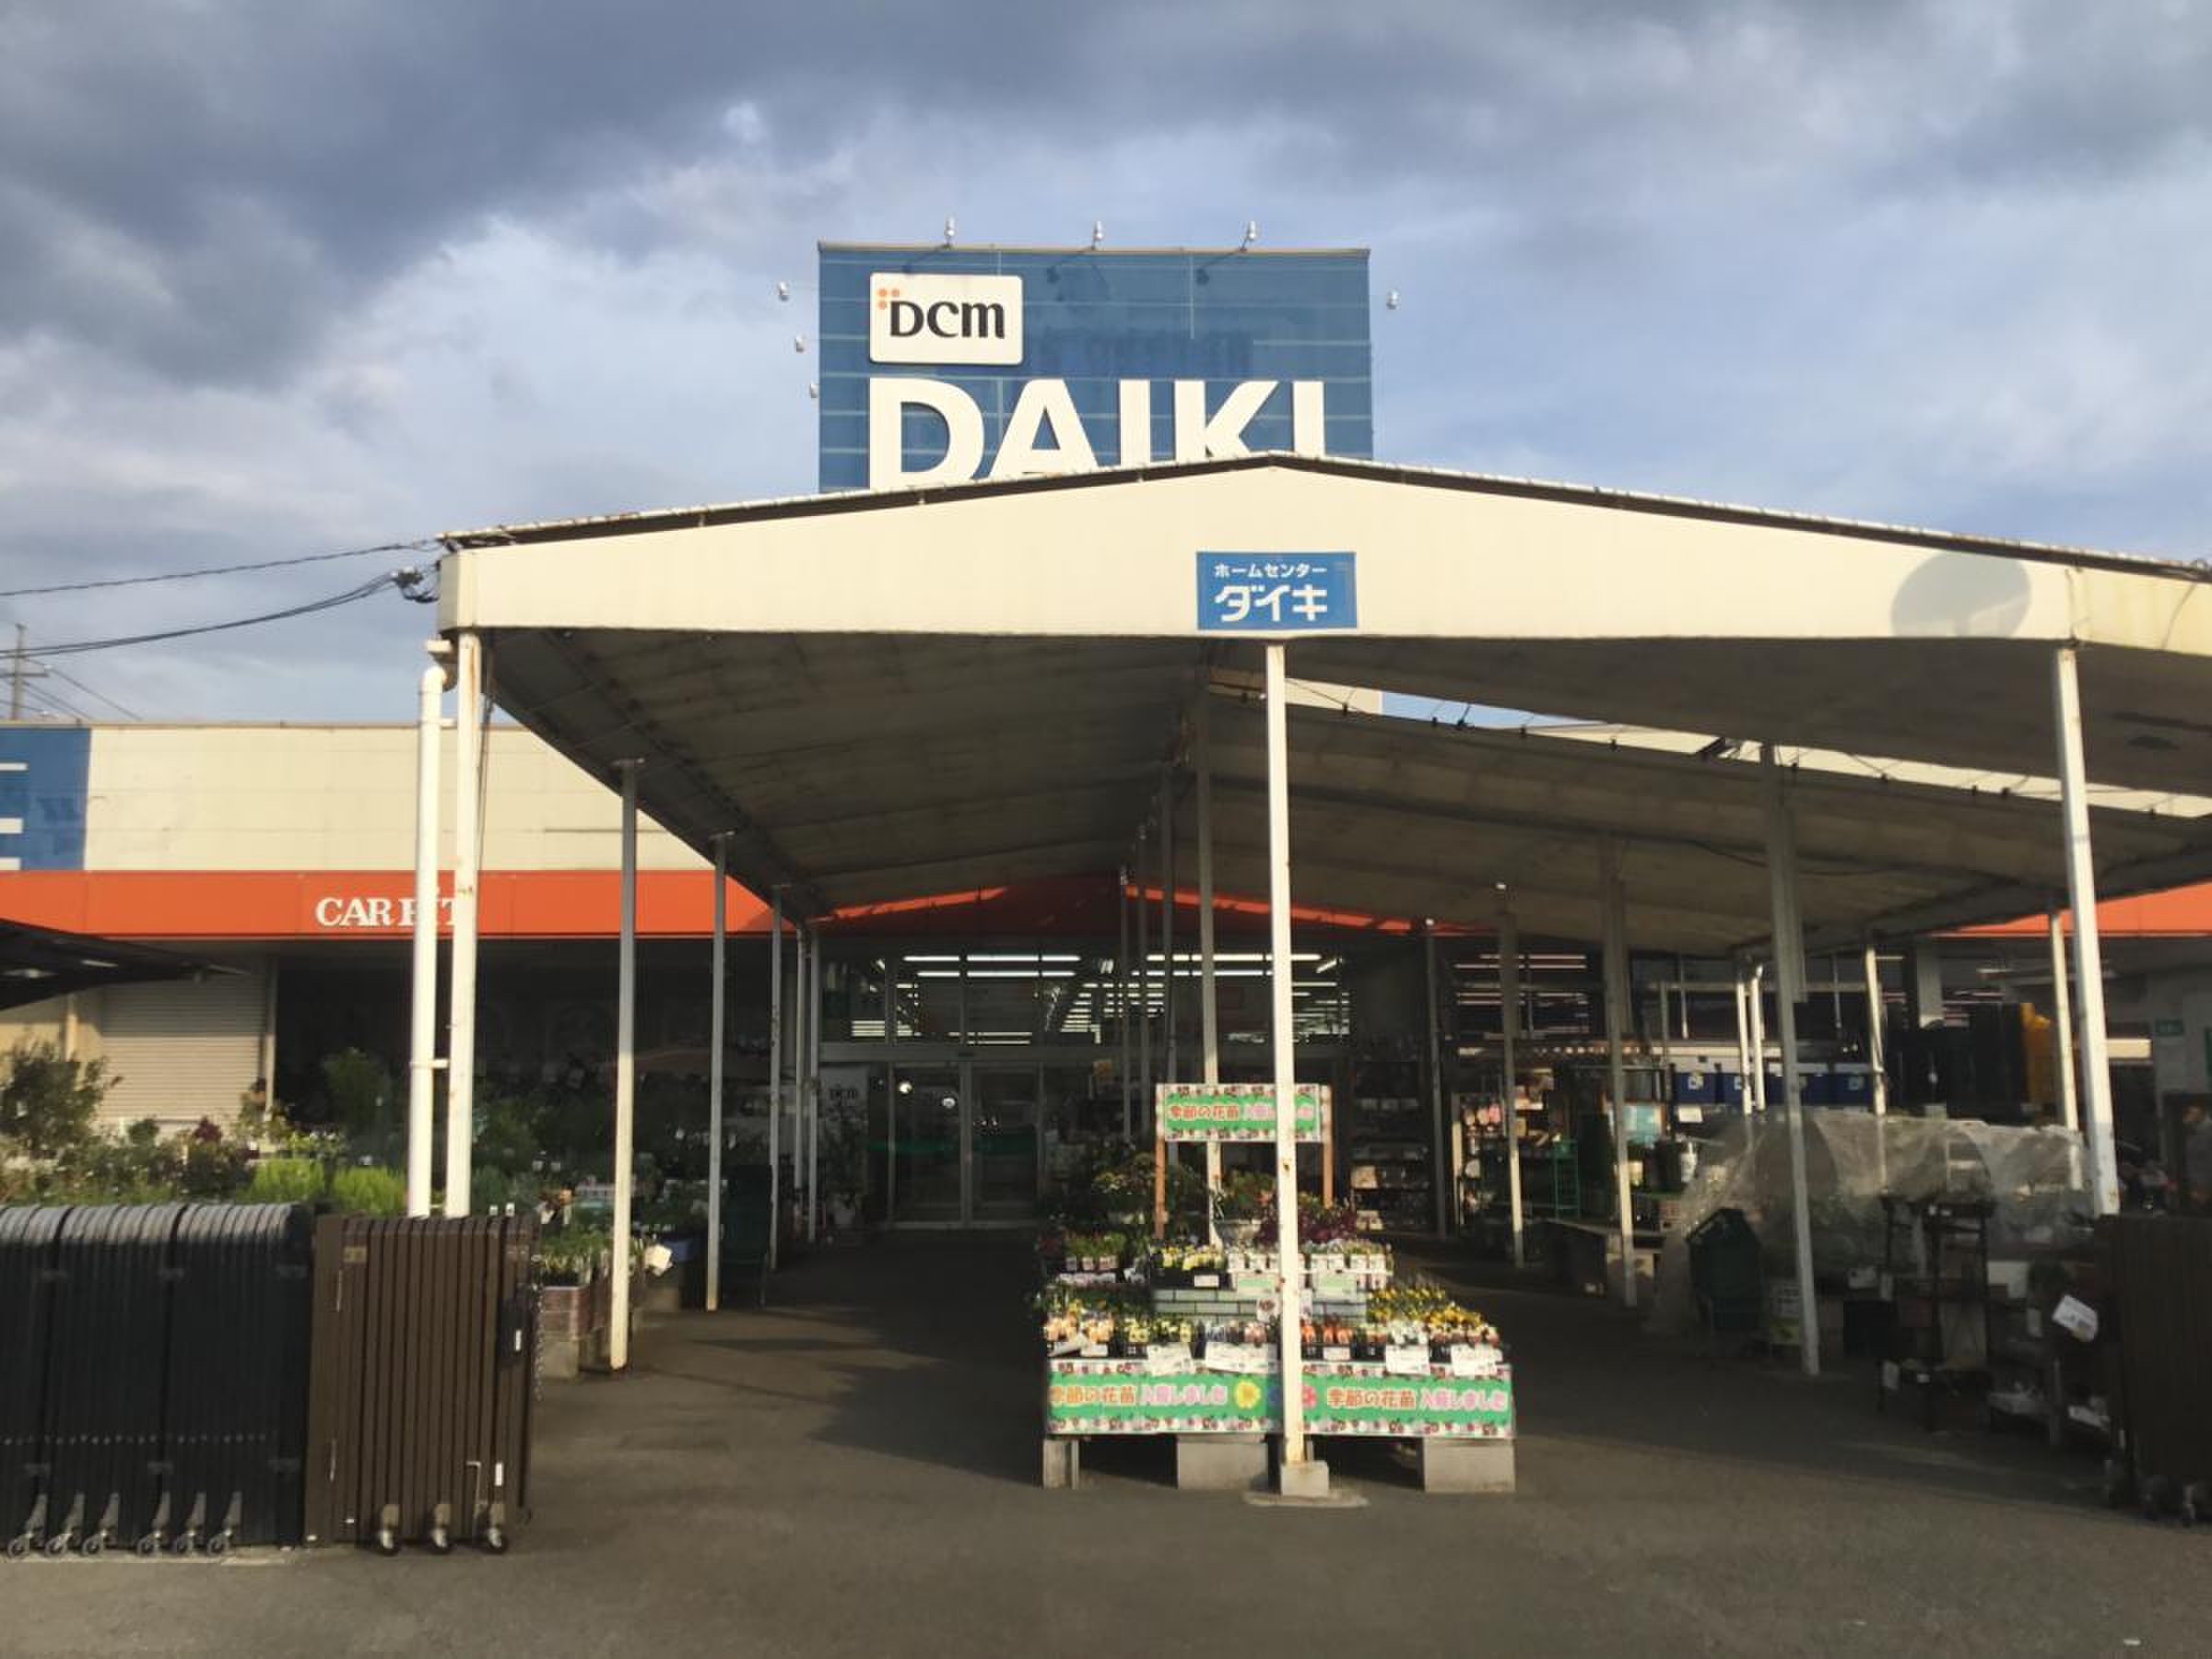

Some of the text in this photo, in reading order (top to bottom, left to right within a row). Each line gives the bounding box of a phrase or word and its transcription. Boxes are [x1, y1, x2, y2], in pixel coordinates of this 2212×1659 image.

[869, 376, 1326, 490] DAIKI
[1214, 562, 1327, 578] ホームセンター
[1214, 583, 1328, 622] ダイキ
[314, 897, 393, 927] CAR
